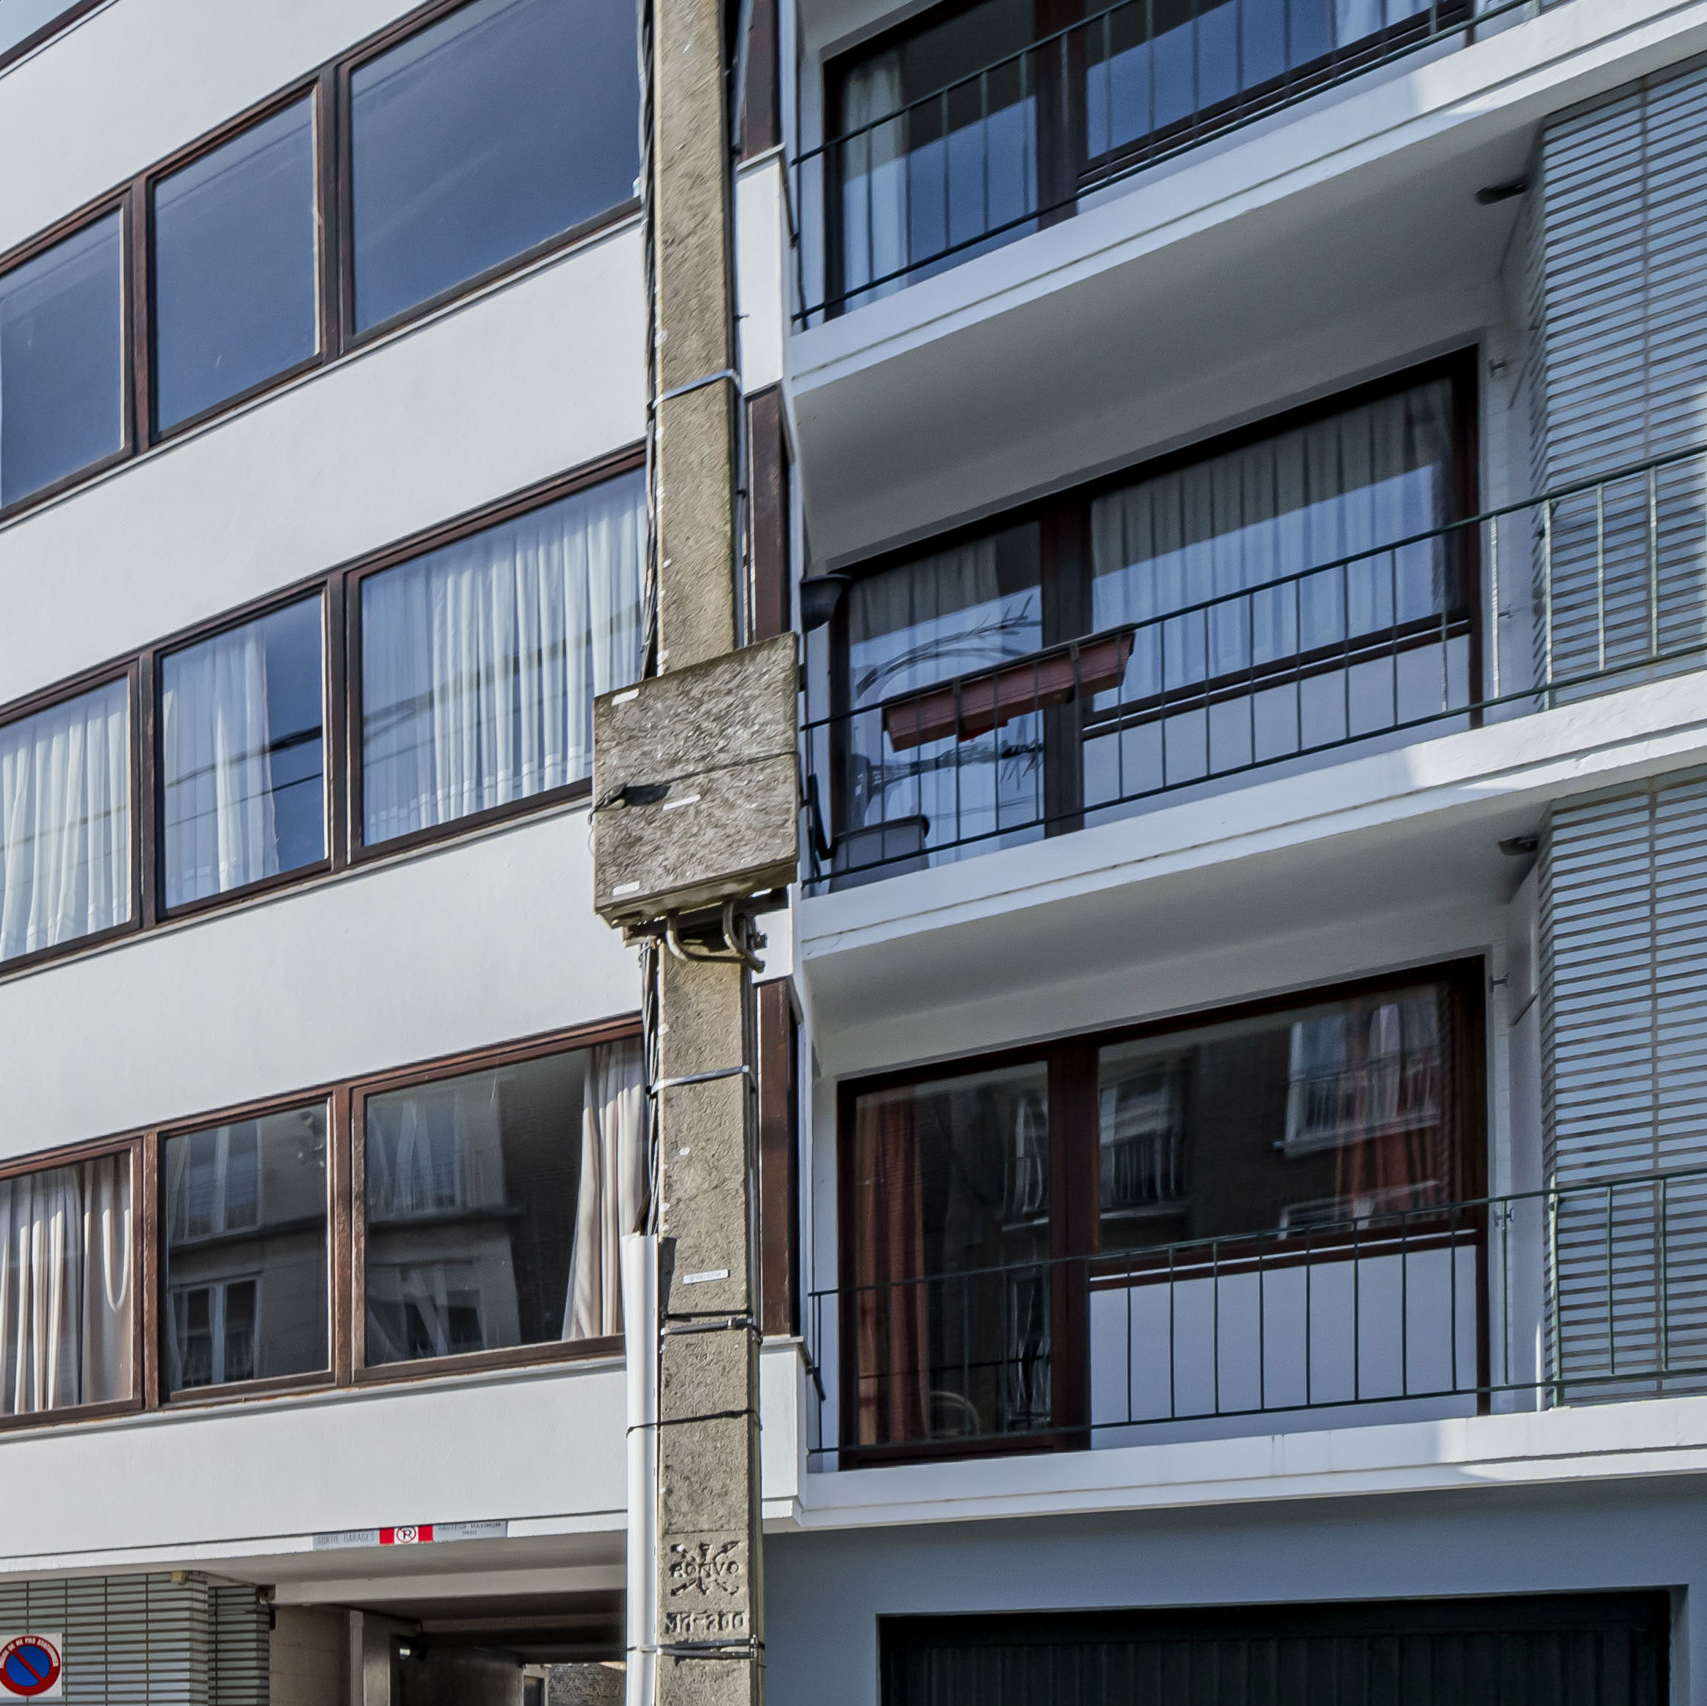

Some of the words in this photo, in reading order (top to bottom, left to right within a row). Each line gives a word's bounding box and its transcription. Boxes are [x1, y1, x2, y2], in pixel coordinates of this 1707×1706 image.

[343, 1532, 375, 1543] GARAGES
[15, 1638, 24, 1647] NE
[24, 1637, 36, 1645] PAS
